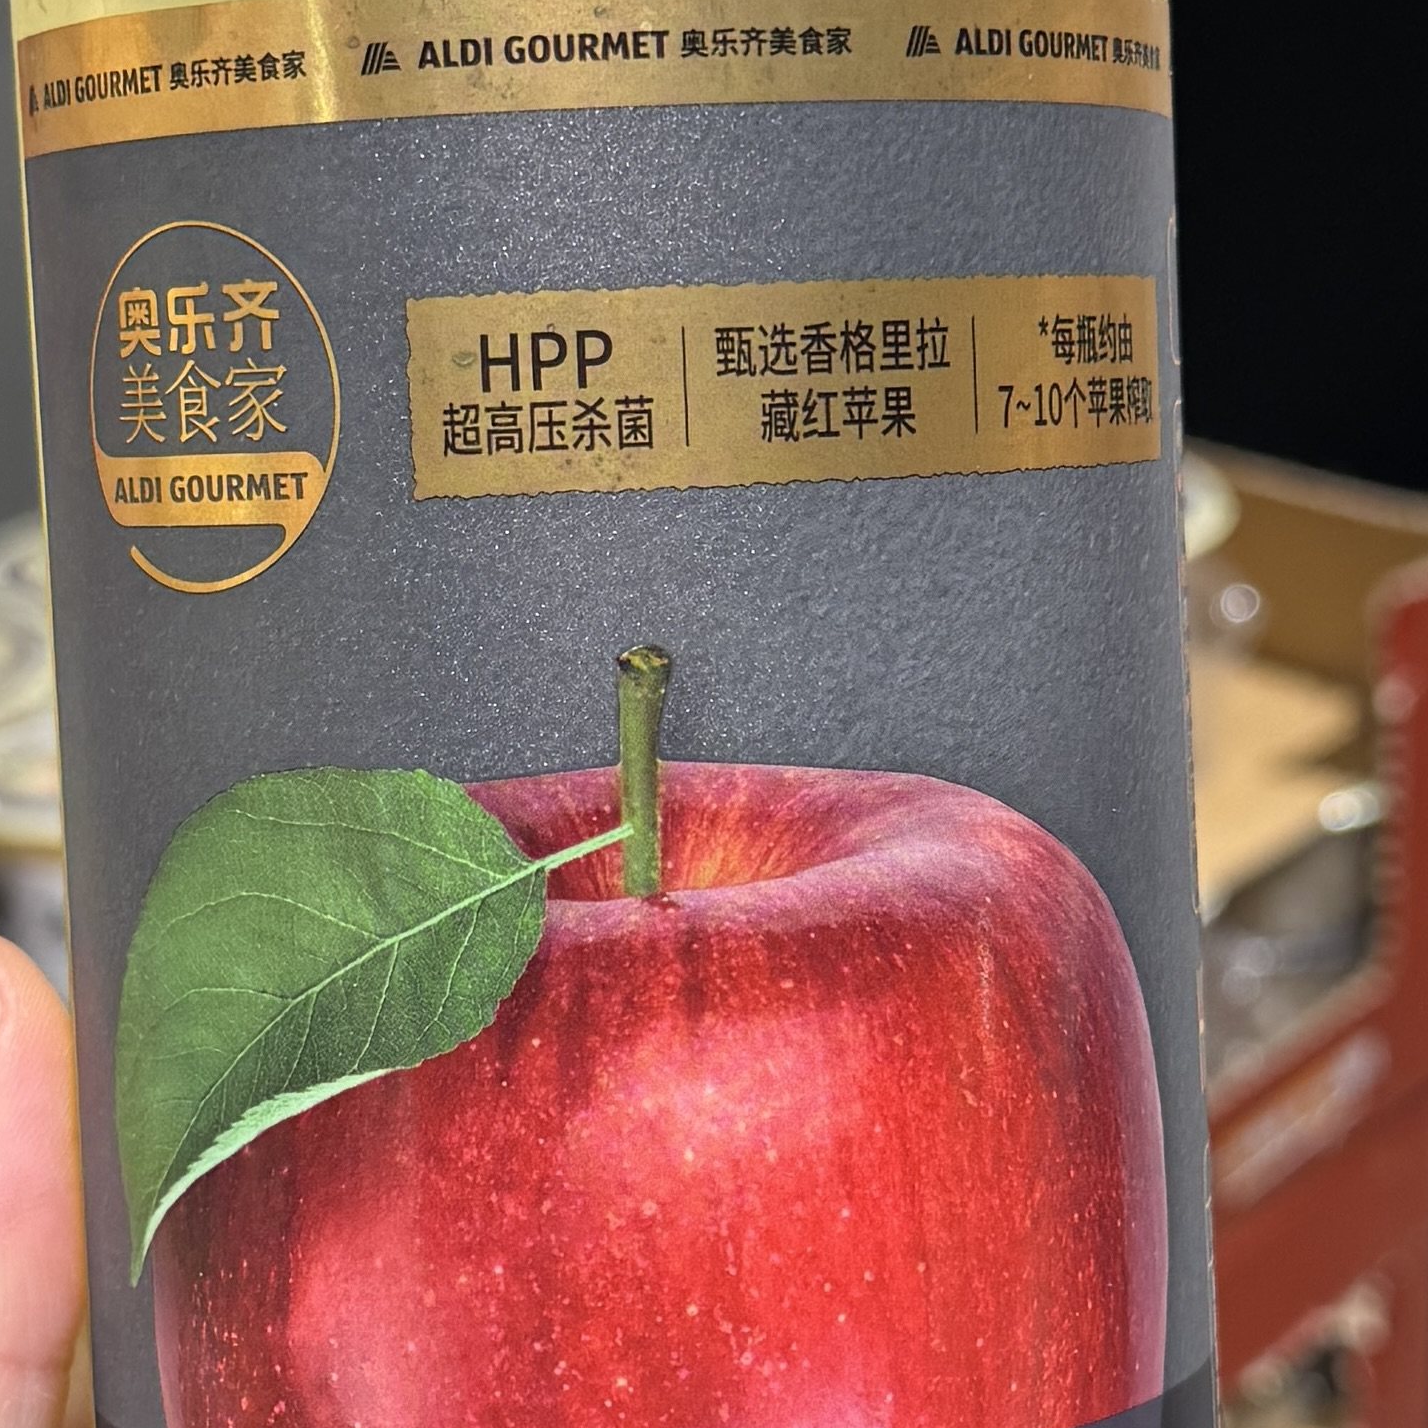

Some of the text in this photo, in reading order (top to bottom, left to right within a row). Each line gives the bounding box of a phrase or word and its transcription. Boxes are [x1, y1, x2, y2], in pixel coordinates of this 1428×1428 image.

[418, 25, 853, 70] ALDI GOURMET 奥乐齐美食家
[955, 28, 1012, 57] ALDI
[1019, 29, 1109, 62] GOURMET
[43, 53, 307, 109] ALDI GOURMET 奥乐齐美食家
[118, 278, 280, 359] 奥乐齐
[715, 317, 950, 379] 甄选香格里拉
[478, 328, 614, 393] HPP
[119, 357, 287, 443] 美食家
[442, 395, 654, 457] 超高压杀菌
[760, 385, 916, 442] 藏红苹果
[114, 472, 309, 504] ALDI GOURMET
